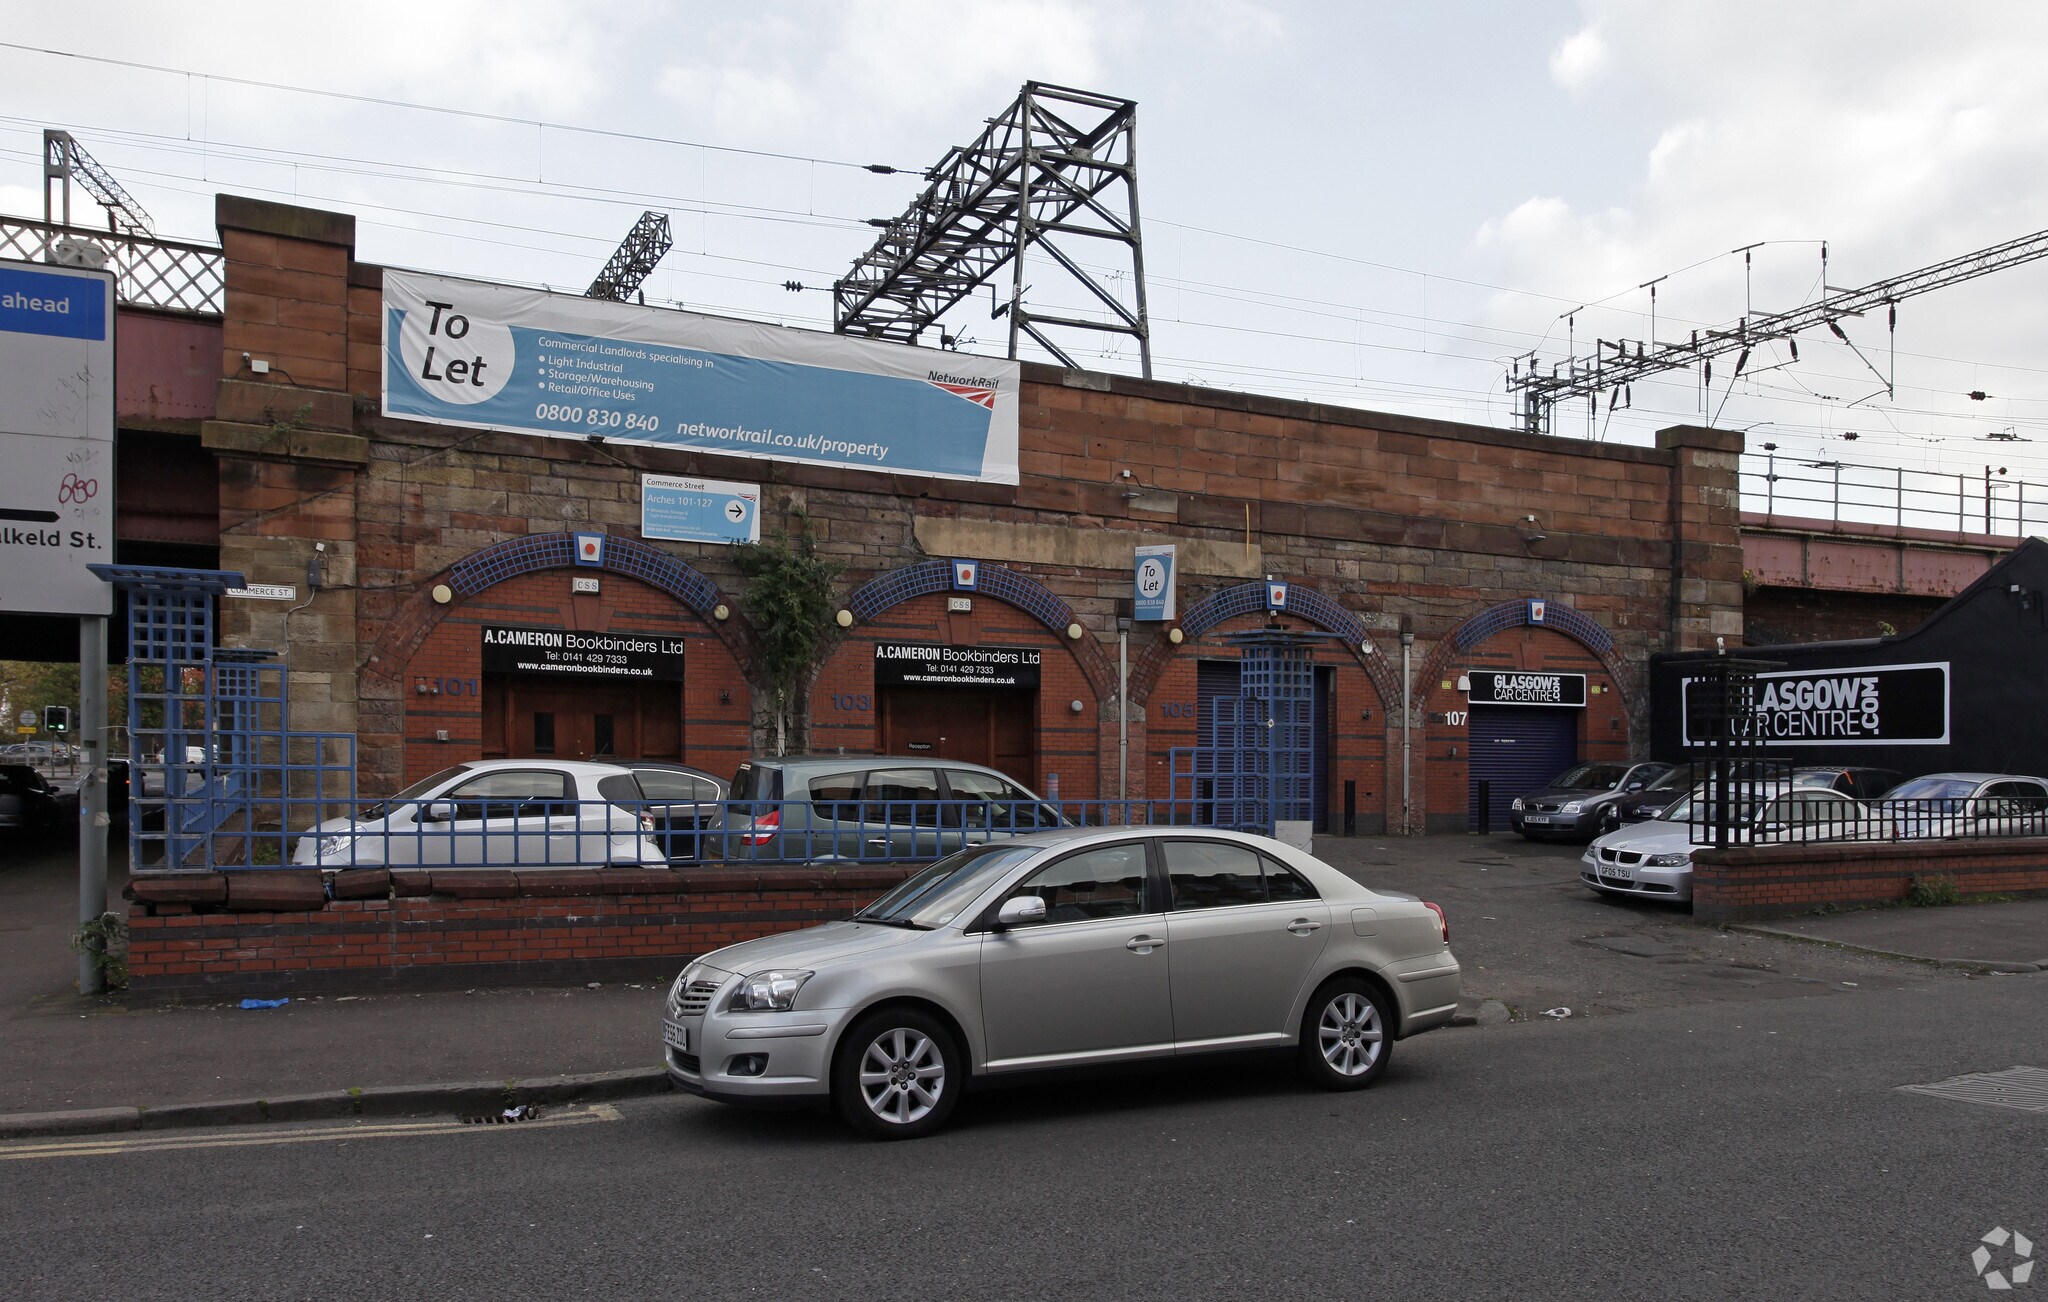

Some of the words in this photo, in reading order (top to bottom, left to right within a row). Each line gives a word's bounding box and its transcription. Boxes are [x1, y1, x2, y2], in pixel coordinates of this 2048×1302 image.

[2, 292, 69, 314] ahead
[425, 300, 469, 339] To
[538, 336, 598, 354] Commercial
[600, 343, 647, 360] Landlords
[649, 351, 703, 369] specialising
[705, 358, 714, 369] in
[422, 346, 488, 387] Let
[548, 355, 574, 371] Light
[576, 358, 623, 374] Industrial
[548, 368, 654, 392] Storage/Warehousing
[927, 370, 1000, 390] NetworkRail
[548, 382, 611, 399] Retail/Office
[612, 388, 636, 401] Uses
[536, 403, 583, 424] 0800
[586, 408, 621, 427] 830
[625, 413, 660, 432] 840
[677, 421, 889, 461] networkrail.co.uk/property
[646, 478, 683, 489] Commerce
[685, 482, 705, 490] Street
[647, 494, 676, 505] Arches
[678, 497, 713, 507] 101-127
[0, 528, 60, 547] lkeld
[70, 531, 102, 549] St.
[1144, 565, 1156, 577] To
[279, 589, 291, 597] ST.
[1143, 580, 1159, 591] Let
[484, 629, 562, 648] A.CAMERON
[566, 634, 657, 653] Bookbinders
[662, 640, 684, 655] Ltd
[545, 651, 560, 661] Tel:
[563, 652, 583, 662] 0141
[586, 653, 603, 663] 429
[606, 655, 627, 664] 7333
[876, 645, 940, 661] A.CAMERON
[943, 648, 1019, 664] Bookbinders
[1022, 652, 1040, 664] Ltd
[517, 661, 653, 676] www.cameronbookbinders.co.uk
[926, 663, 939, 672] Tel:
[941, 664, 957, 673] 0141
[960, 665, 974, 674] 429
[976, 666, 994, 675] 7333
[434, 677, 477, 696] 101
[903, 674, 1015, 684] www.cameronbookbinders.co.uk
[1494, 675, 1553, 690] GLASGOW
[832, 693, 871, 711] 103
[1494, 688, 1514, 700] CAR
[1515, 689, 1553, 702] CENTRE
[1741, 678, 1861, 711] LASGOW
[1161, 703, 1194, 718] 105
[1861, 677, 1879, 735] .COM
[1445, 711, 1467, 726] 107
[1774, 710, 1861, 736] CENTRE
[1617, 867, 1631, 878] TSU
